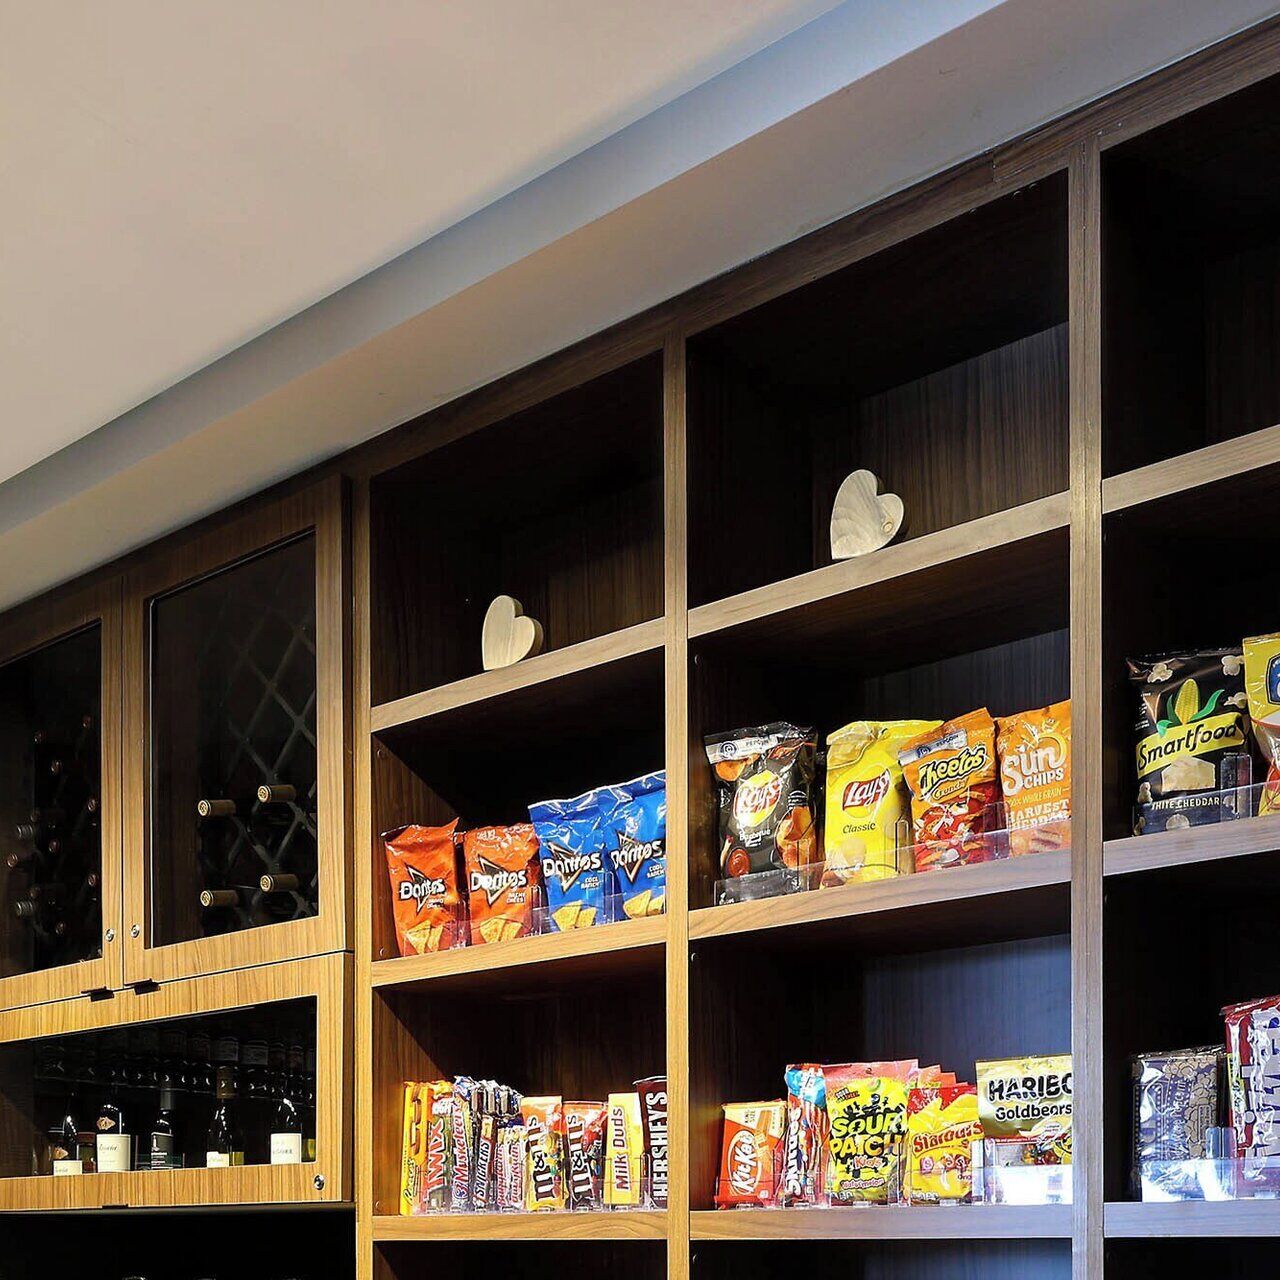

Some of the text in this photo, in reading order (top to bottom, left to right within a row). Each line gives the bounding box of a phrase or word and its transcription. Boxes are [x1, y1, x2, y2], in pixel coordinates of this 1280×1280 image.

[1139, 720, 1237, 770] Smartfood
[919, 744, 988, 793] Cheetos
[1001, 734, 1066, 796] Sun
[1022, 767, 1065, 790] CHIPS
[843, 769, 891, 809] Lay's
[1176, 798, 1220, 808] CHEDDAR
[842, 822, 876, 834] Classic
[542, 851, 603, 878] Doritos
[610, 839, 664, 870] Doritos
[399, 878, 446, 900] Doritos
[470, 869, 527, 892] Doritos
[996, 1104, 1072, 1122] Goldbears
[453, 1105, 468, 1182] Musketeers
[610, 1107, 629, 1191] Milk Duds
[476, 1140, 491, 1200] SNICKERS
